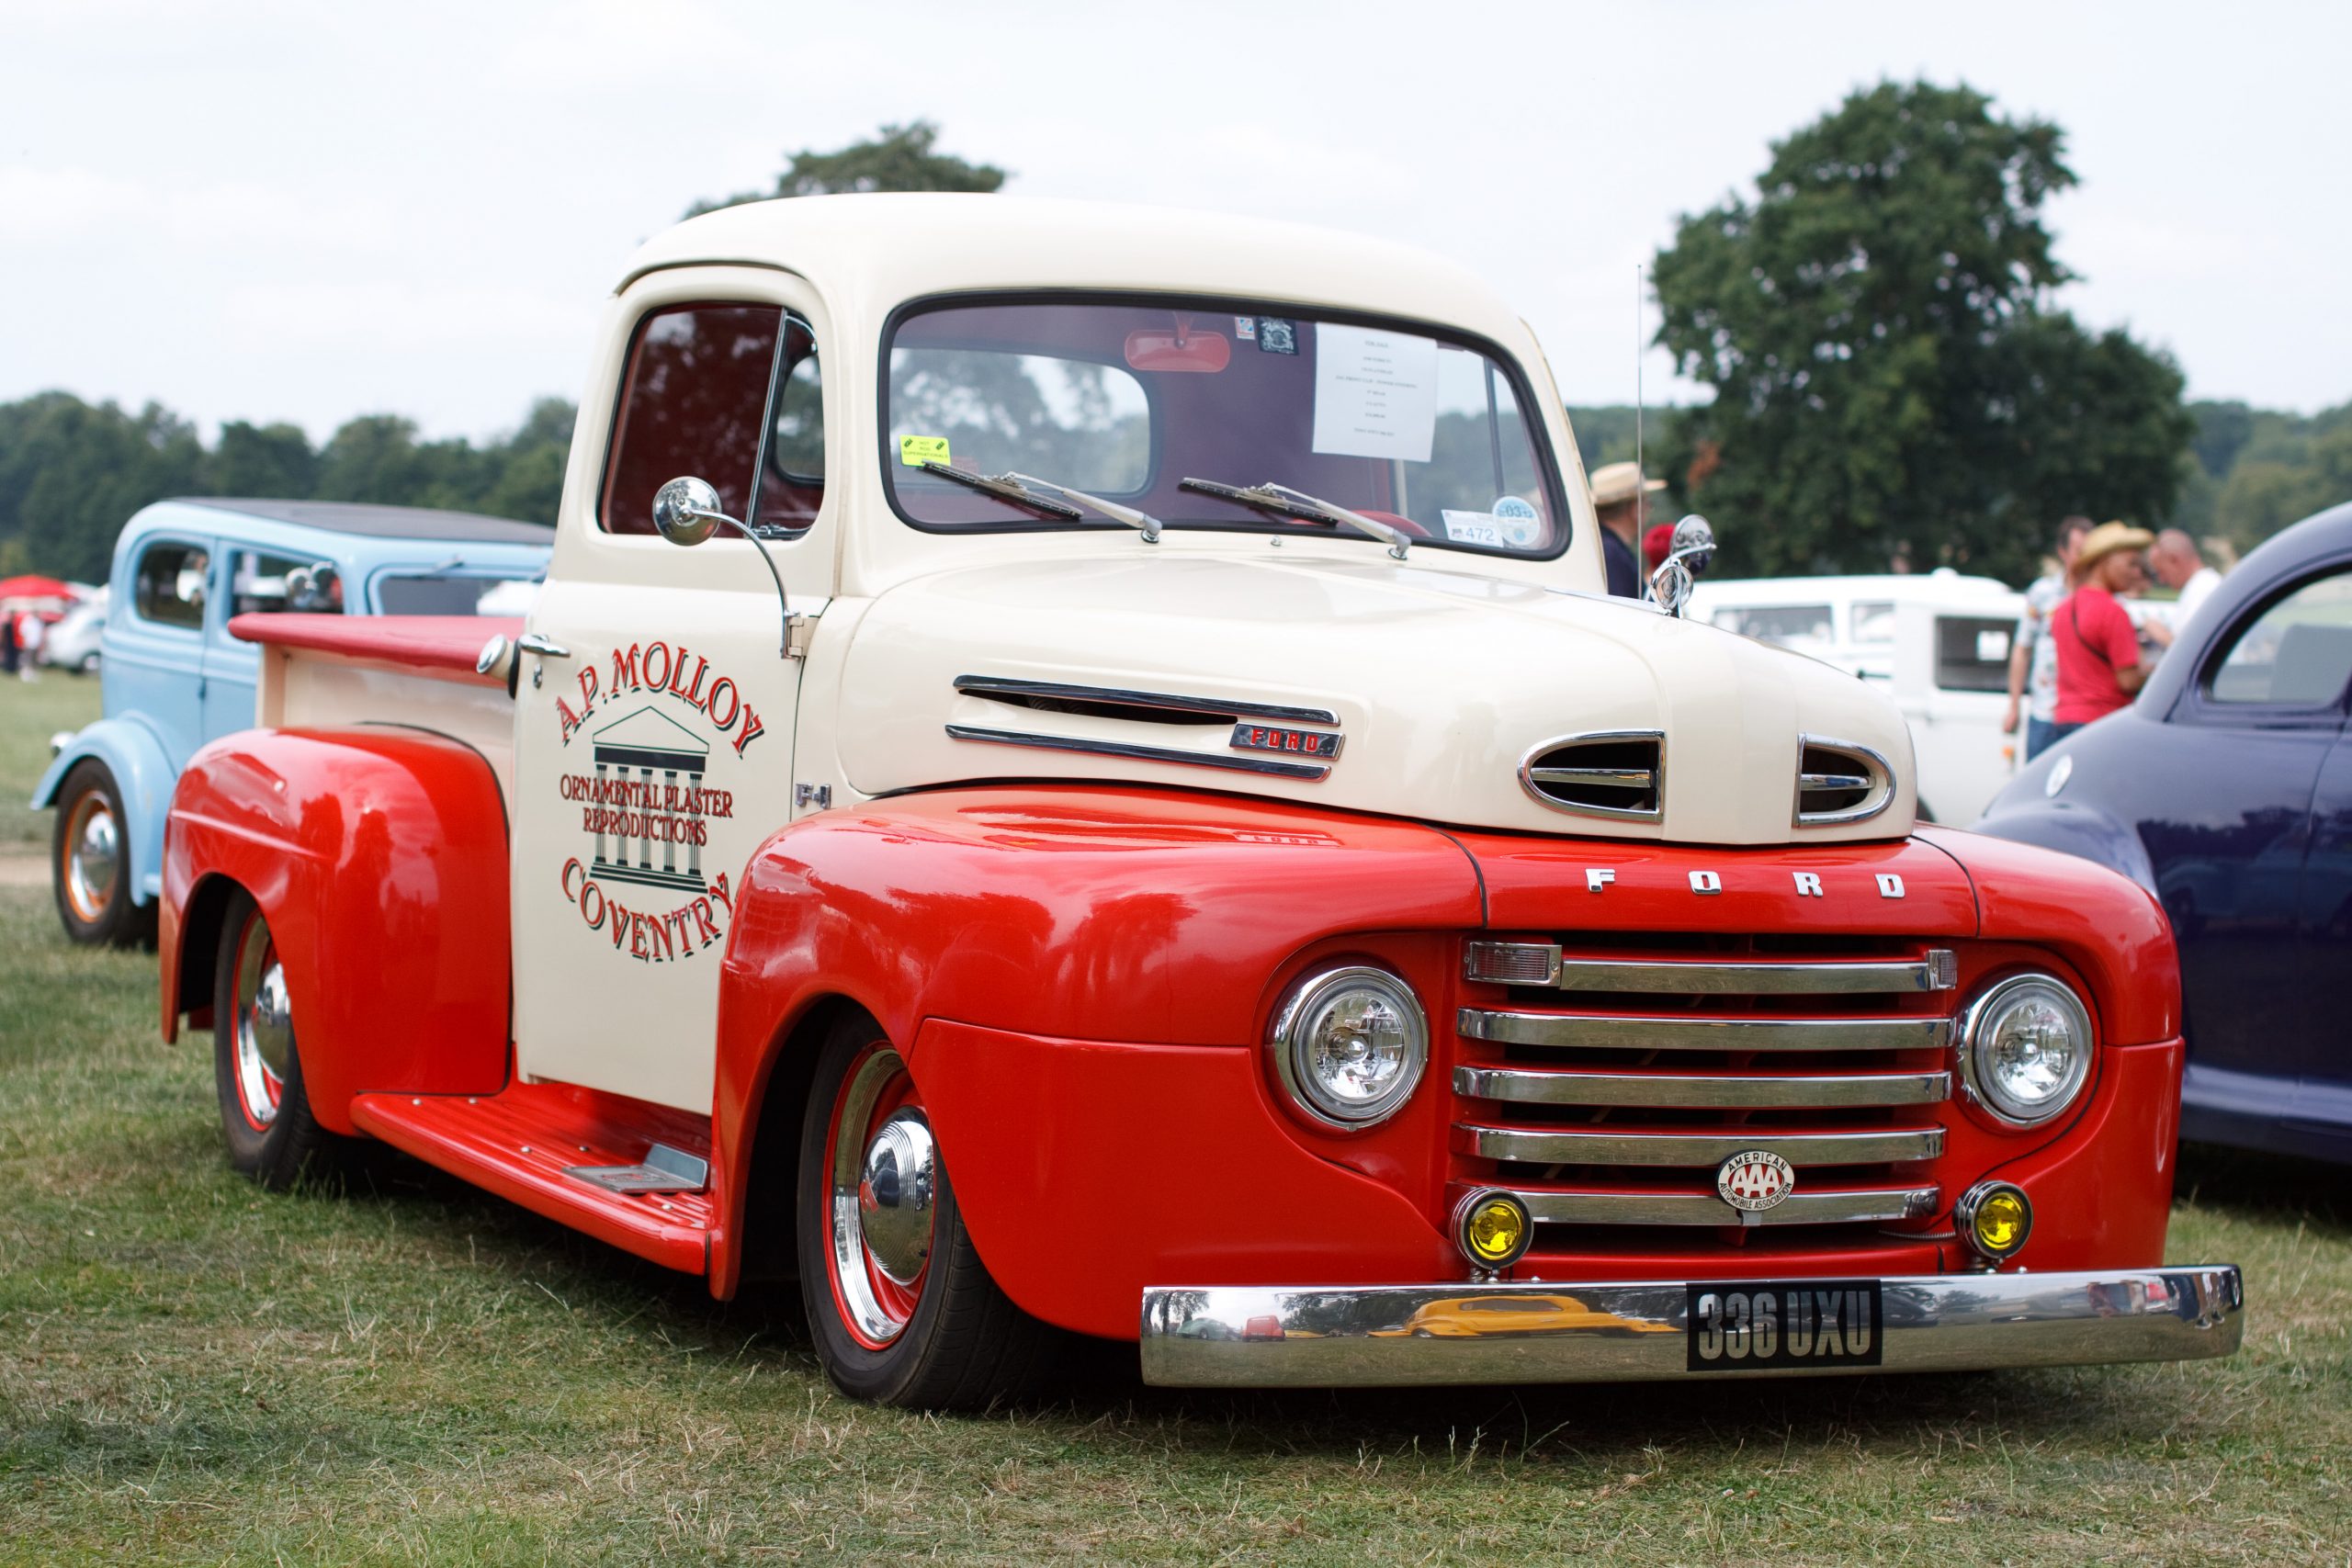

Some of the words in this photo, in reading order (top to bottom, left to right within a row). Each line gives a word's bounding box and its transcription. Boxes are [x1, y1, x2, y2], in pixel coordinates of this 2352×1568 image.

[1506, 505, 1521, 517] 03
[1465, 527, 1495, 542] 472
[610, 641, 764, 760] MOLLOY
[1250, 728, 1318, 752] FORD
[560, 773, 662, 811] ORNAMENTAL
[663, 784, 734, 818] PLASTER
[582, 807, 708, 847] REPRODUCTIONS
[1585, 868, 1906, 898] FORD
[561, 856, 733, 963] COVENTRY
[1727, 1152, 1788, 1173] AMERICAN
[1719, 1182, 1753, 1210] AUTOMOBILE
[1754, 1181, 1792, 1209] ASSOCIATION
[1730, 1163, 1781, 1200] AAA
[1698, 1292, 1778, 1360] 336
[1786, 1290, 1871, 1358] UXU
